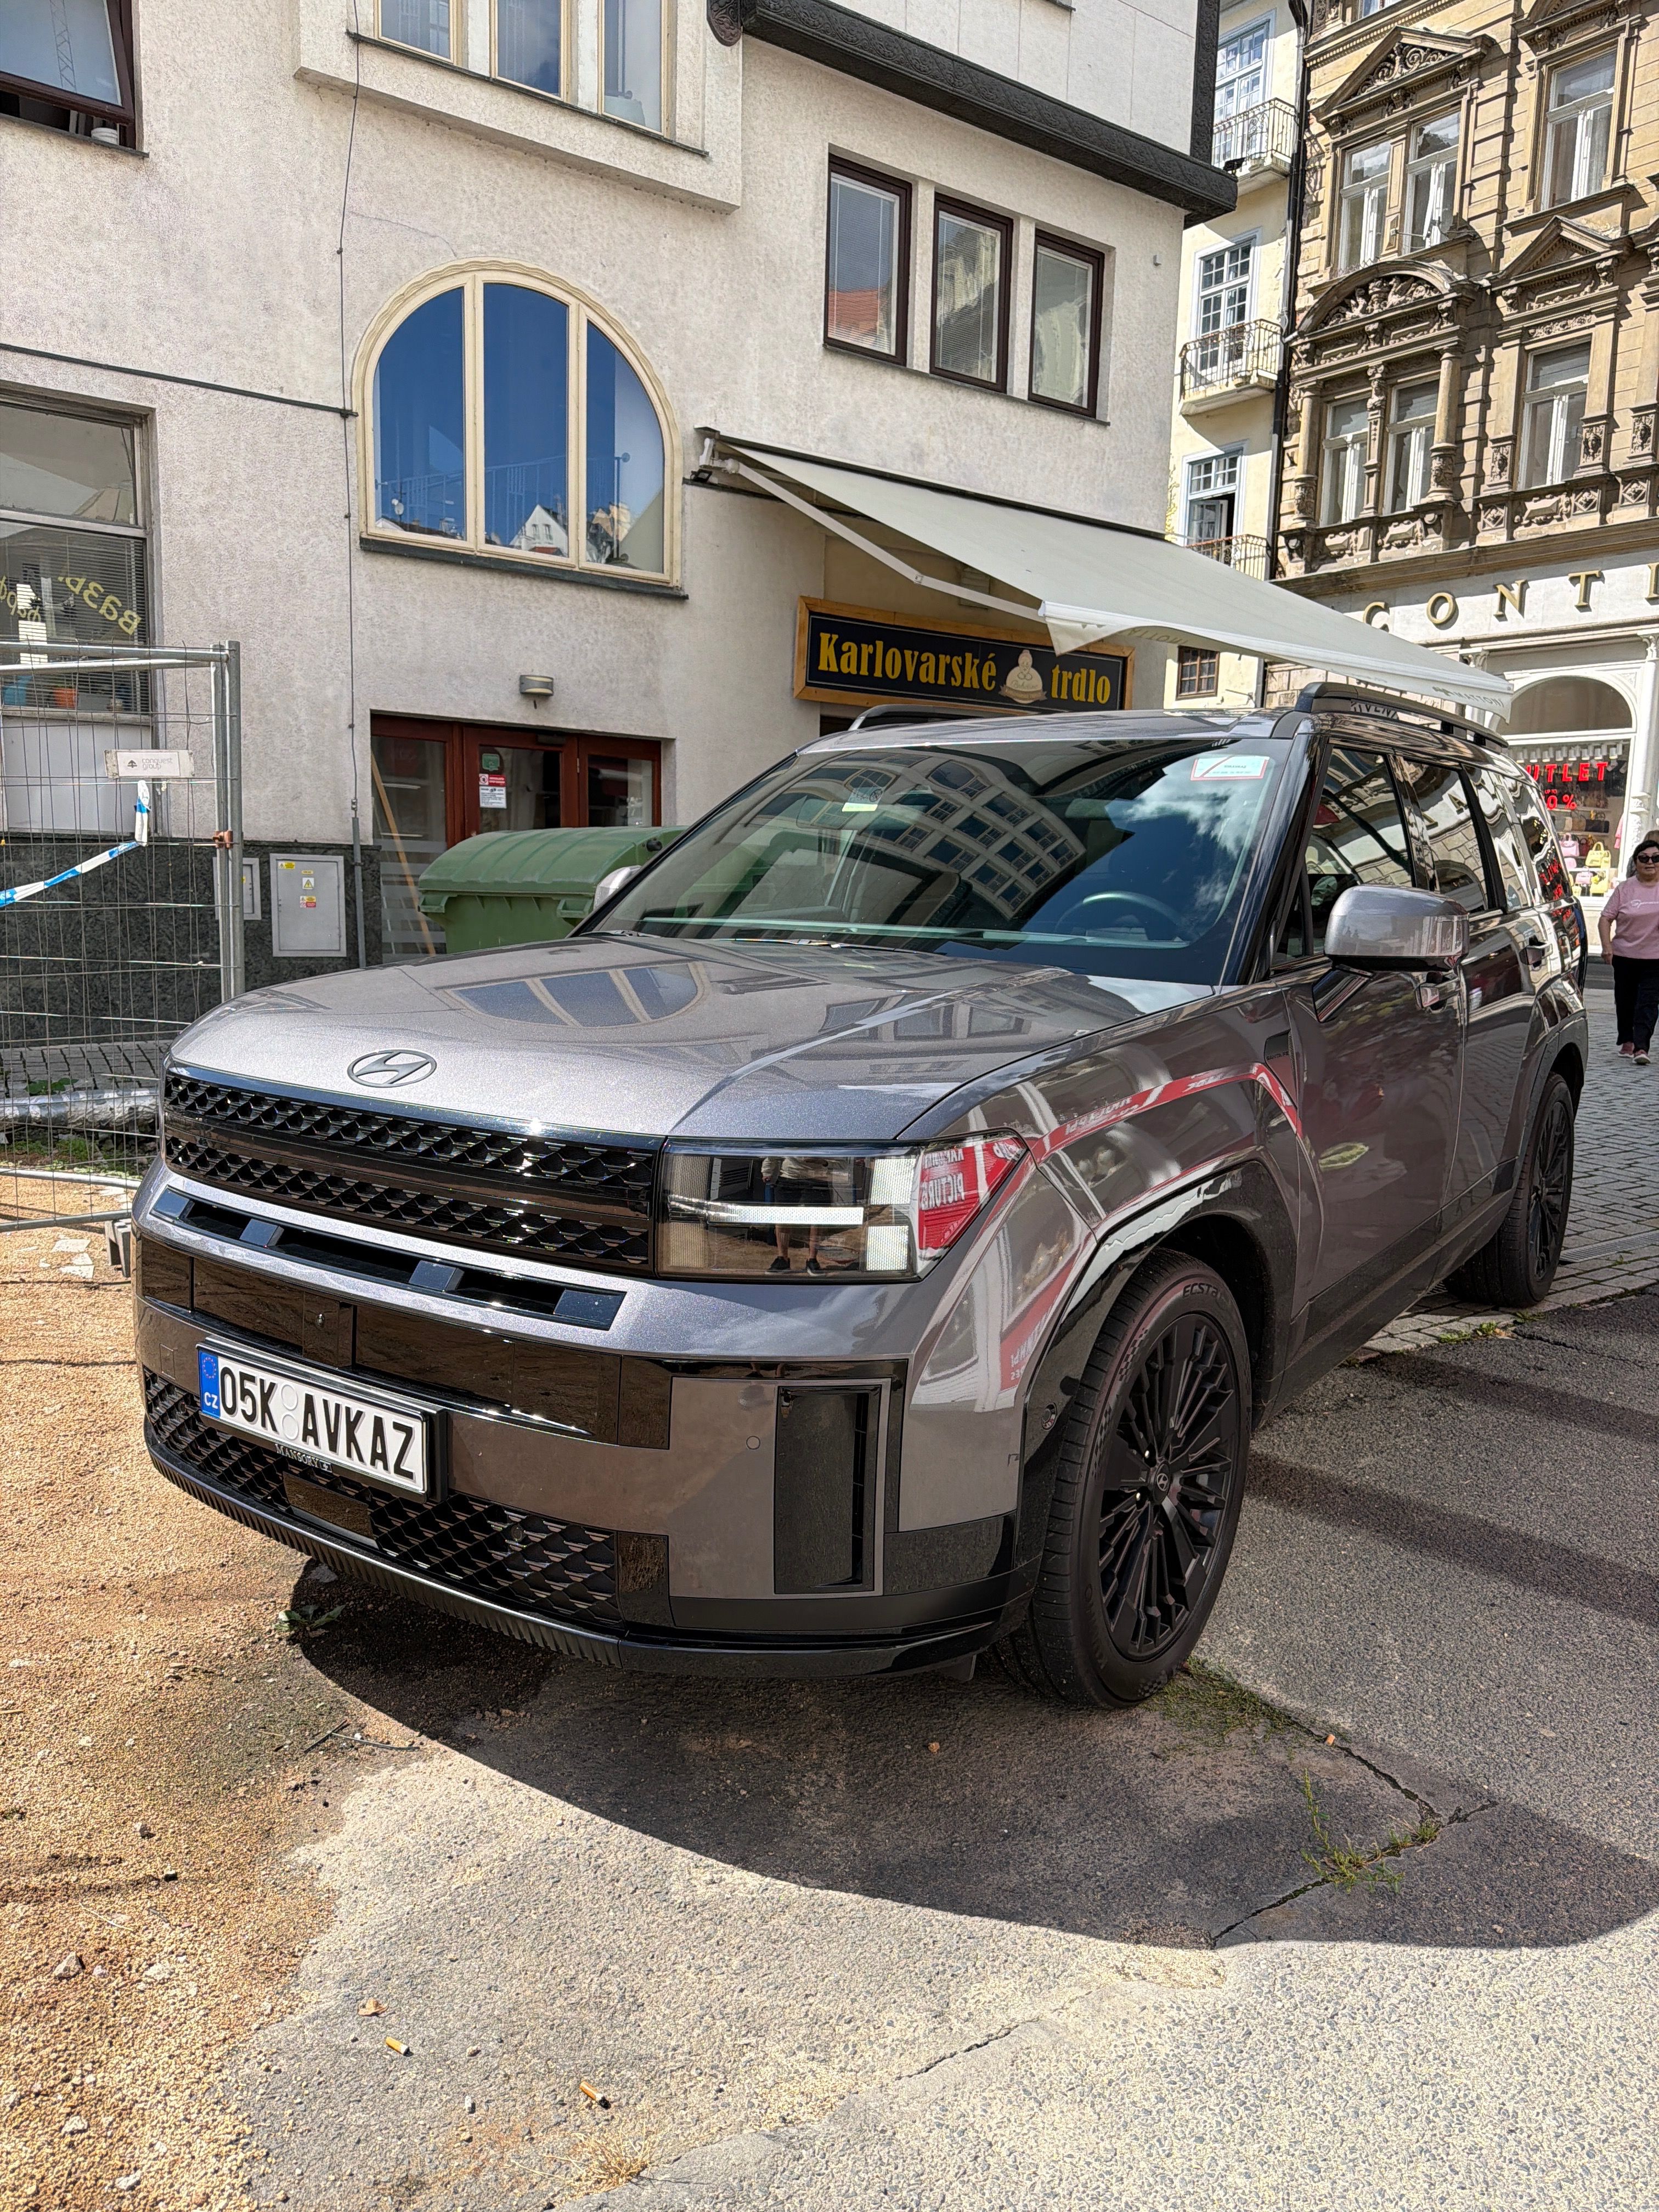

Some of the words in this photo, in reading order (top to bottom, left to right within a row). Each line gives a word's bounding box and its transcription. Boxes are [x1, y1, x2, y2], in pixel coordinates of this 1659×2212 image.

[818, 633, 997, 691] Karlovarské
[1051, 664, 1110, 704] trdlo
[204, 1392, 218, 1409] CZ
[221, 1367, 279, 1435] 05K
[302, 1393, 414, 1480] AVKAZ
[275, 1444, 319, 1469] MANSORY
